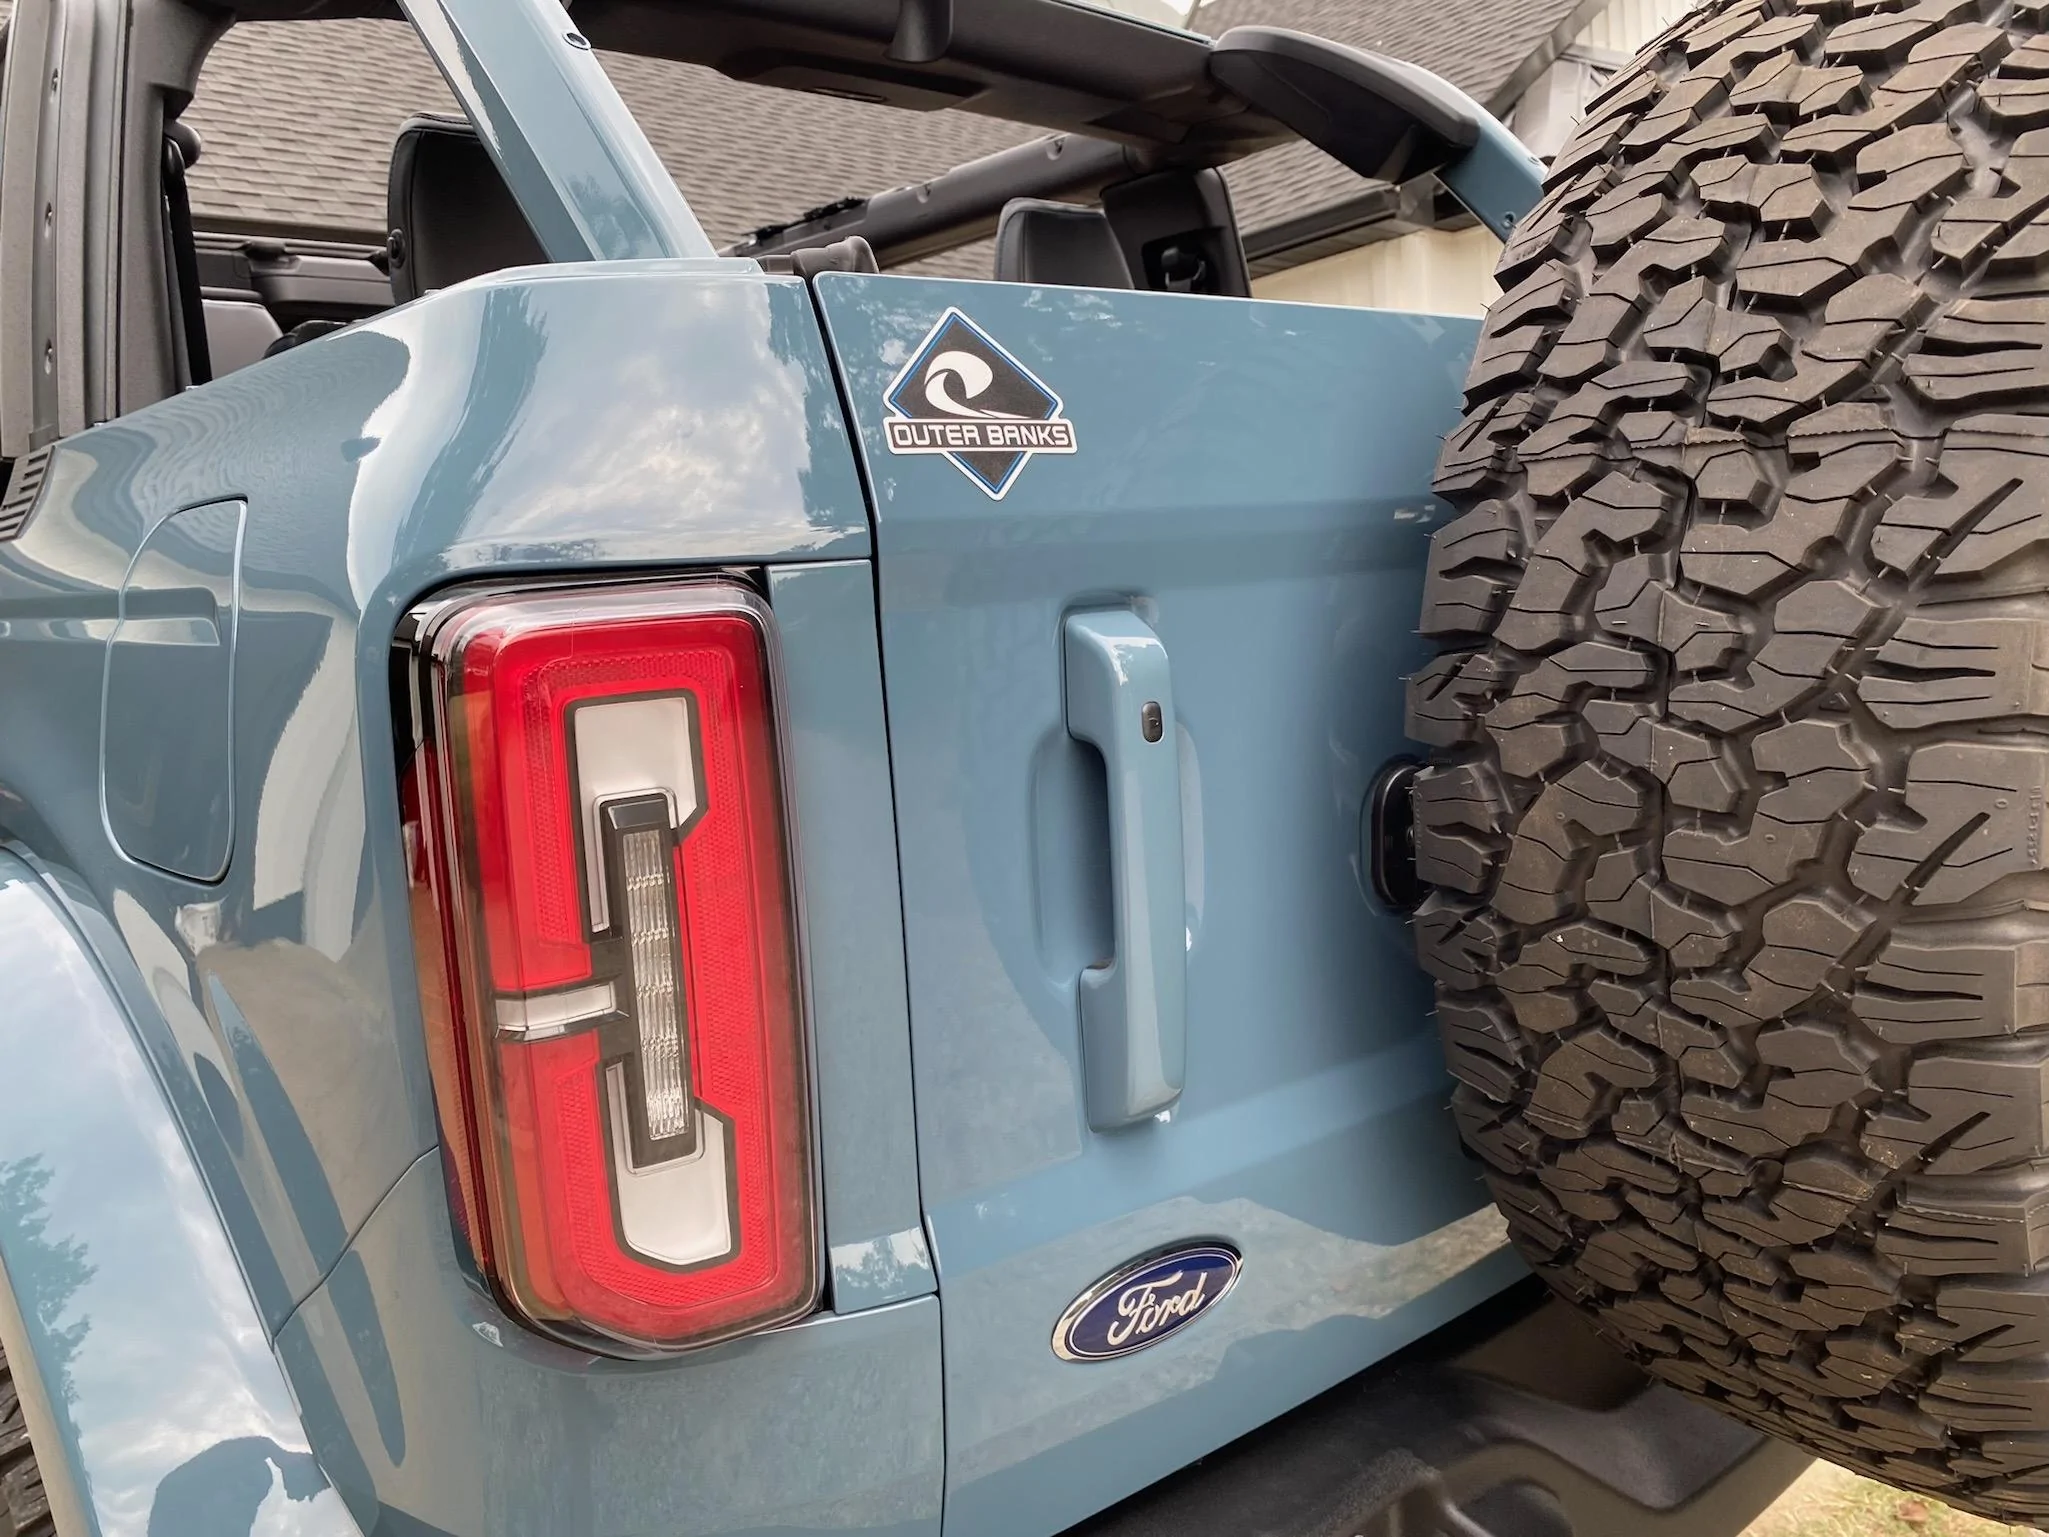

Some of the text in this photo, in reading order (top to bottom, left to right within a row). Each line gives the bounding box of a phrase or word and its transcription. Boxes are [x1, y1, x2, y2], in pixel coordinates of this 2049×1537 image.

[893, 424, 1069, 446] OUTER BANKS
[1107, 1269, 1208, 1346] Ford
